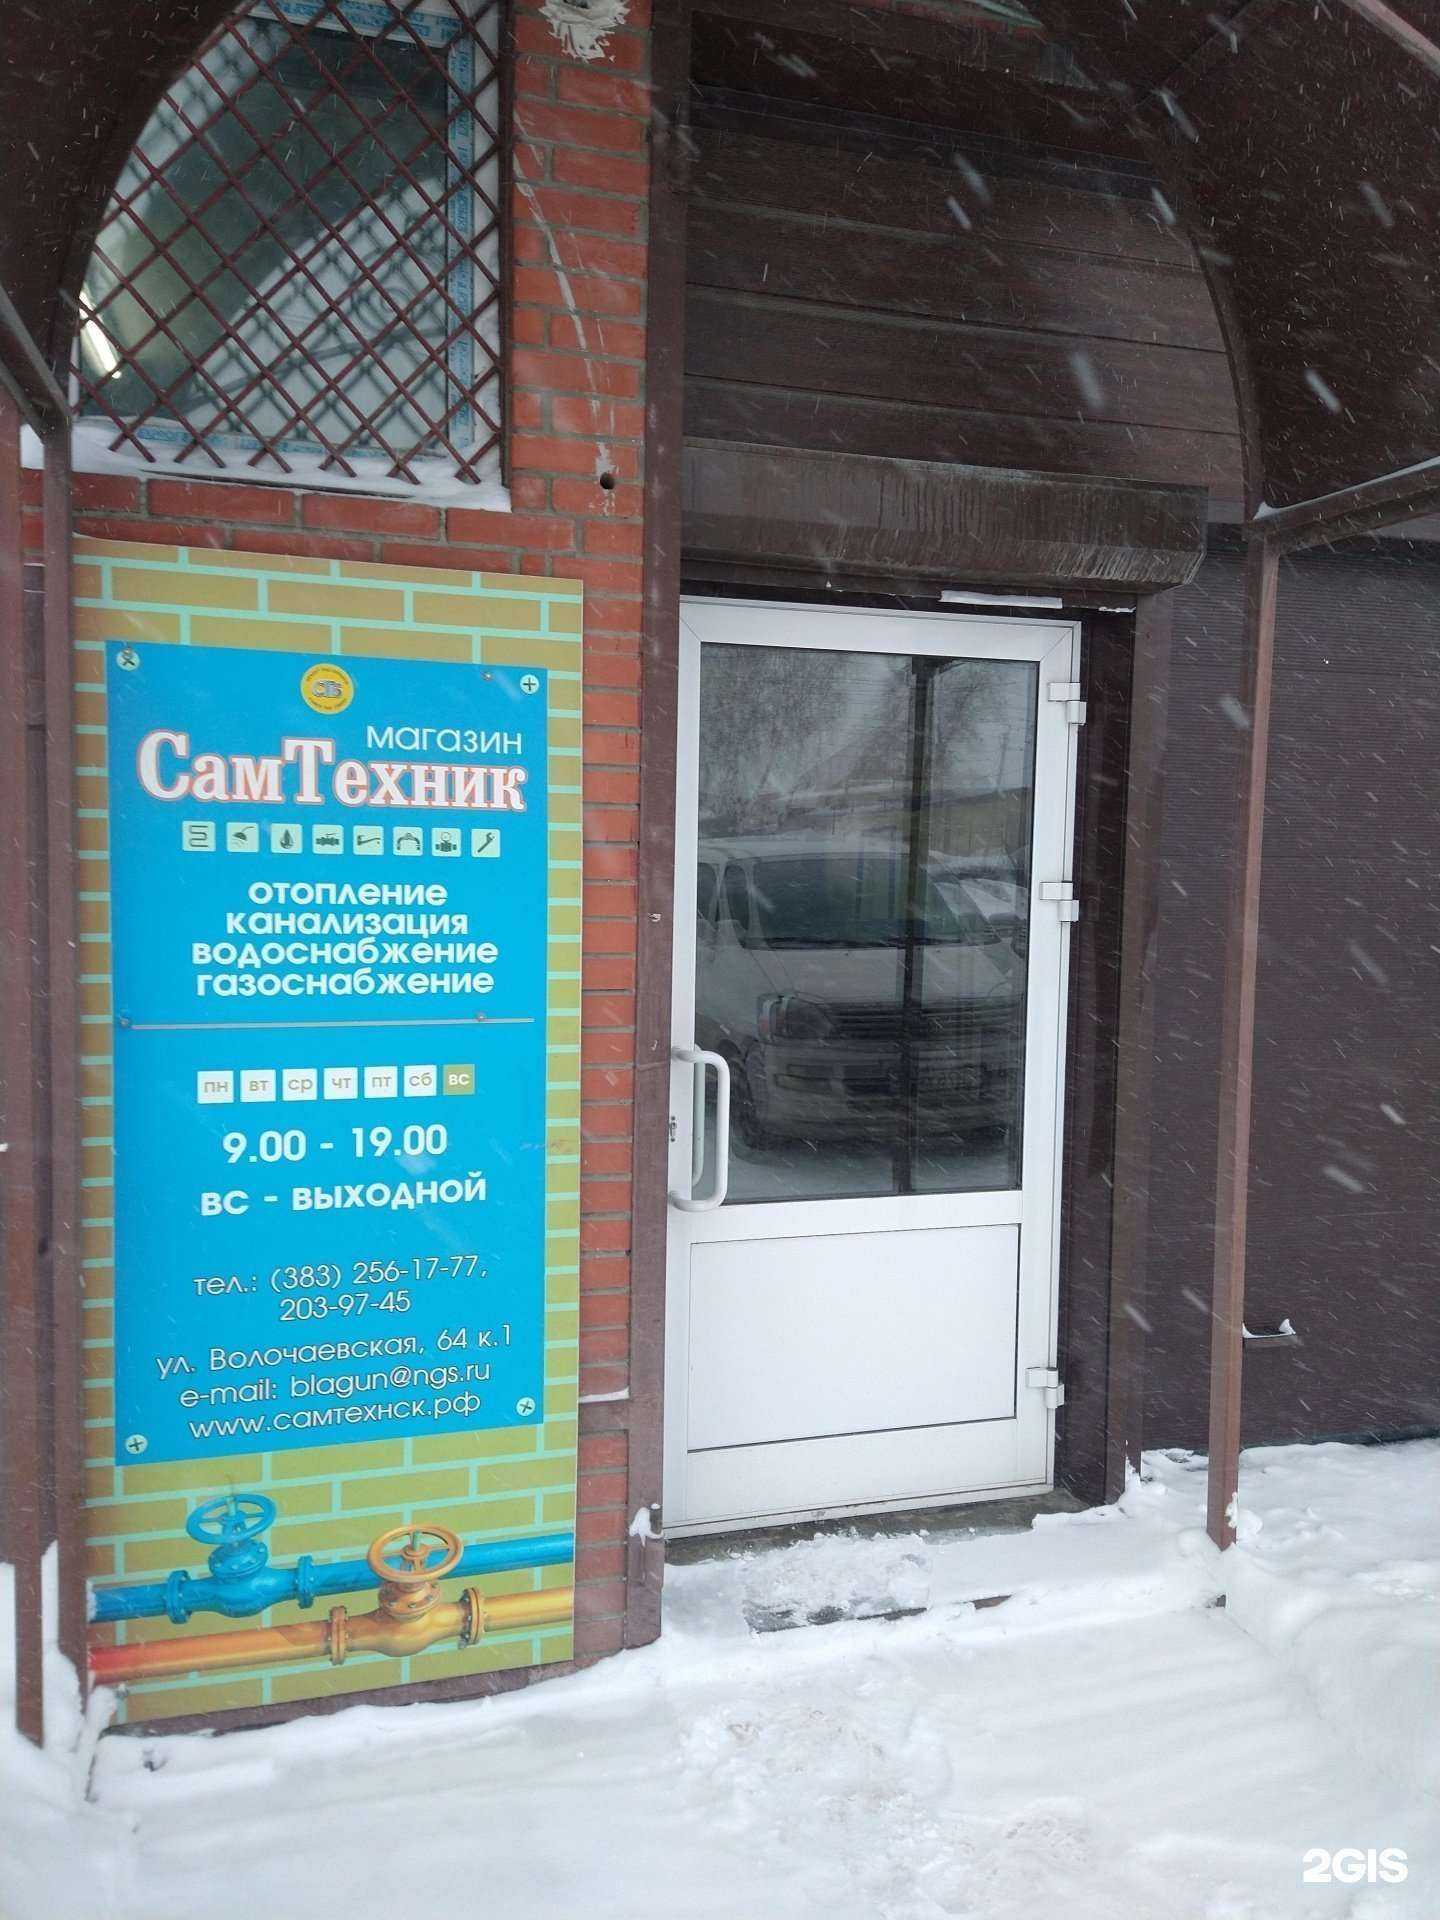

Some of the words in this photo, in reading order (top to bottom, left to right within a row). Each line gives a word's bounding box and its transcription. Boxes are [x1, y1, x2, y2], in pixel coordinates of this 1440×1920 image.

[367, 724, 523, 755] магазин
[137, 729, 528, 812] СамТехник
[248, 881, 448, 905] отопление
[226, 912, 469, 938] канализация
[192, 936, 498, 968] водоснабжение
[197, 967, 494, 997] газоснабжение
[204, 1079, 229, 1095] пн
[248, 1077, 269, 1092] вт
[288, 1076, 313, 1096] ср
[331, 1075, 352, 1090] чт
[371, 1074, 393, 1089] пт
[408, 1071, 433, 1089] сб
[448, 1073, 470, 1087] вс
[222, 1130, 307, 1164] 9.00
[319, 1142, 335, 1150] -
[351, 1124, 448, 1158] 19.00
[200, 1190, 249, 1216] вс
[292, 1170, 487, 1211] выходной
[193, 1272, 257, 1297] тел.:
[270, 1264, 342, 1294] (383)
[352, 1254, 488, 1285] 256-17-77,
[279, 1290, 412, 1321] 203-97-45
[156, 1354, 196, 1379] ул.
[209, 1335, 425, 1372] Волочаевская,
[437, 1327, 468, 1352] 64
[478, 1324, 512, 1348] к.1
[179, 1378, 278, 1409] e-mail:
[290, 1358, 491, 1401] blagun@ngs.ru
[189, 1391, 481, 1440] www.самтехнск.рф
